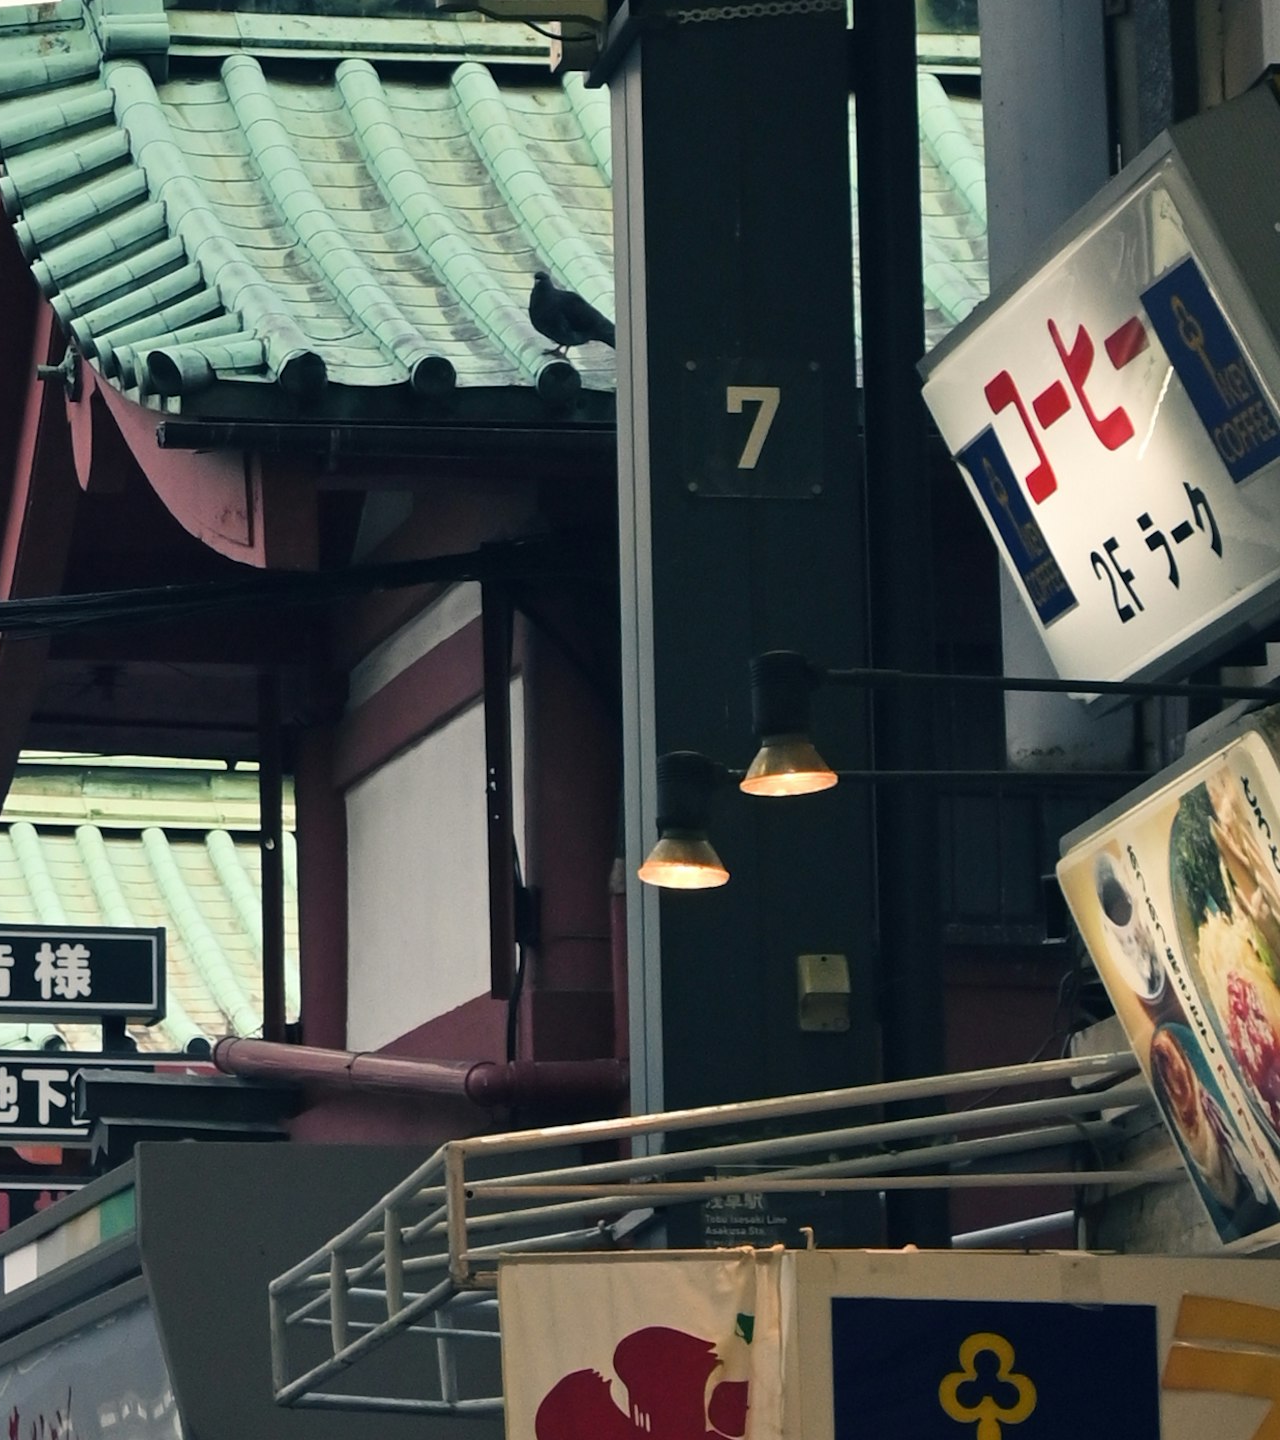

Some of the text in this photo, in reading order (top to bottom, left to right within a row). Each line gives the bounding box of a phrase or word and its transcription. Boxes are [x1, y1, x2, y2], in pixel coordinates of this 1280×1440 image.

[725, 386, 781, 470] 7
[984, 316, 1150, 505] コーヒー
[1213, 397, 1278, 464] COFFEE
[1090, 482, 1223, 623] 2F ラーク
